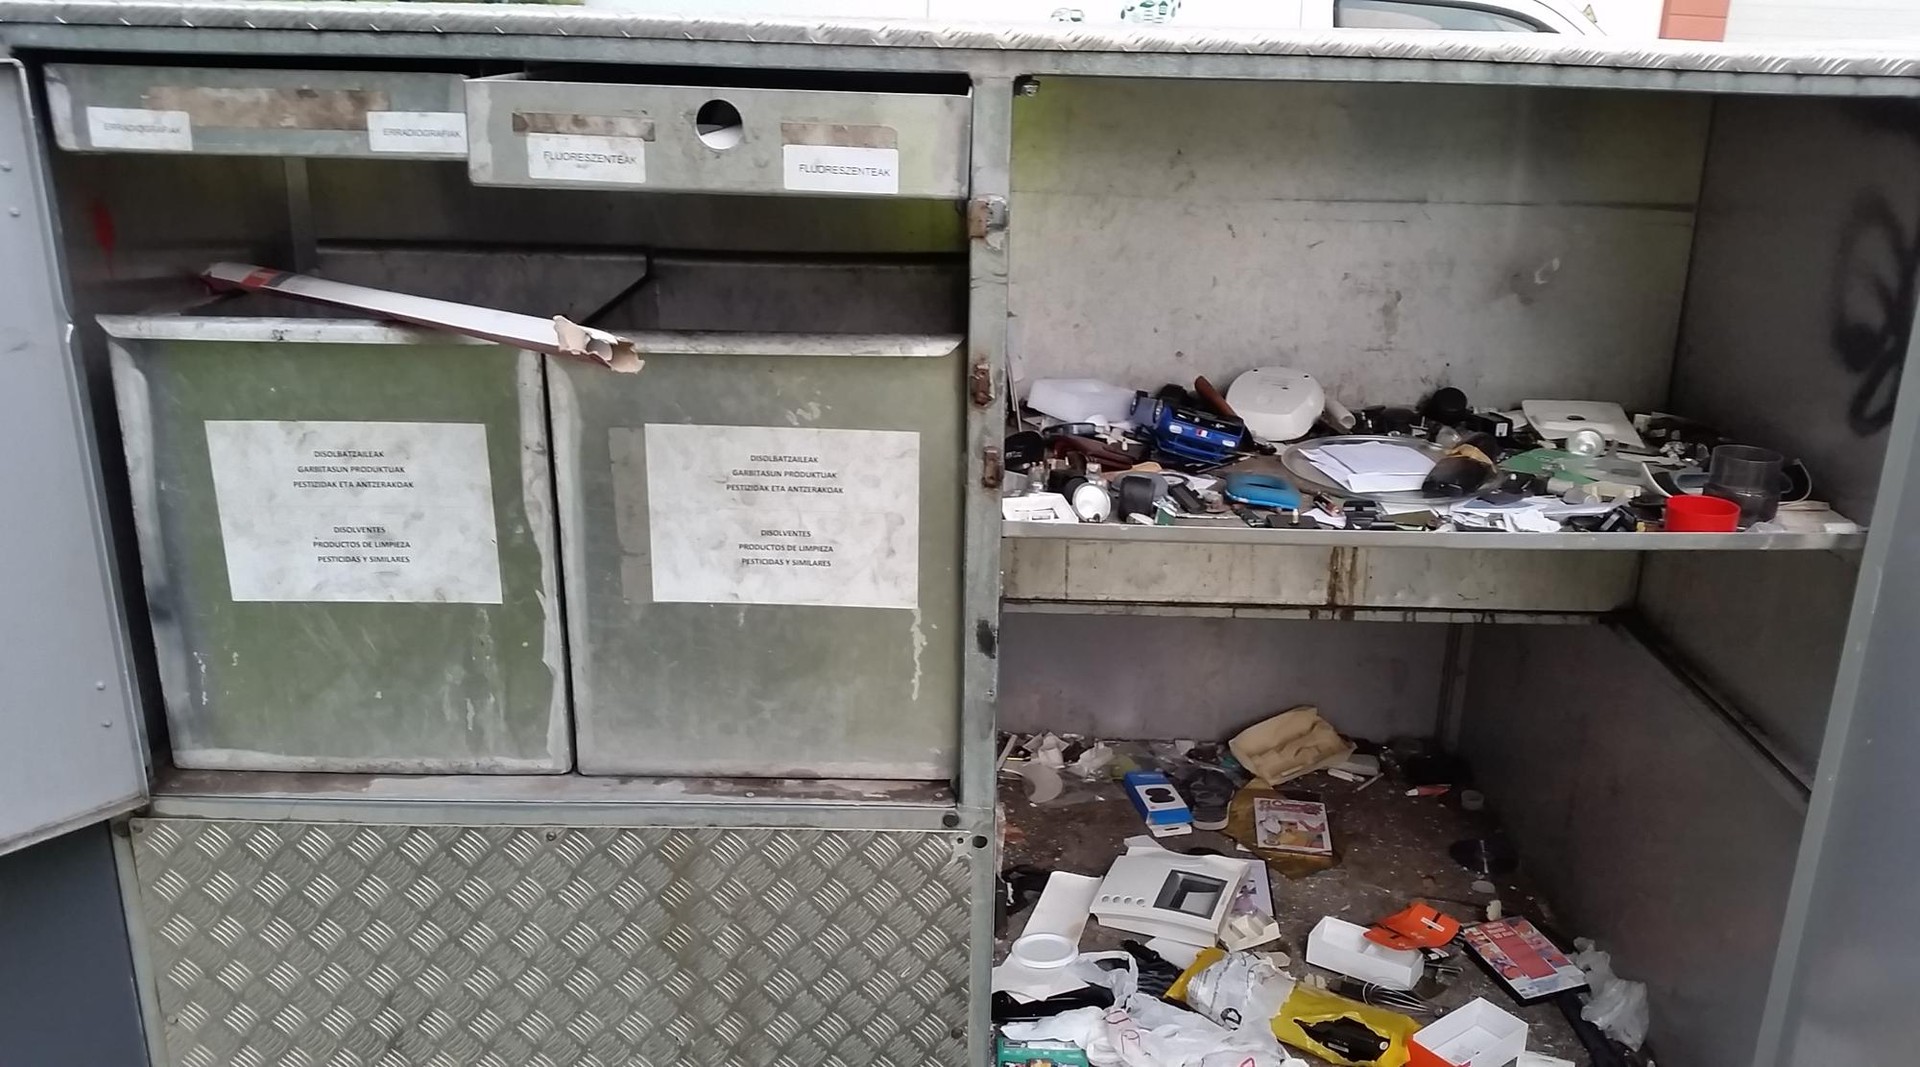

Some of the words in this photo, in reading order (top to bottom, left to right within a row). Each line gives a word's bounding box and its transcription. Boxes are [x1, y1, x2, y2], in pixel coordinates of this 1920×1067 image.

[543, 151, 637, 164] FLUORESZENTEAK
[799, 164, 892, 177] FLUORESZENTEAK
[750, 455, 819, 463] DISOLBATZAILEAK
[732, 469, 782, 477] GARBITASUN
[784, 470, 838, 478] PRODUKTUAK
[788, 486, 844, 494] ANTZERAKOAK
